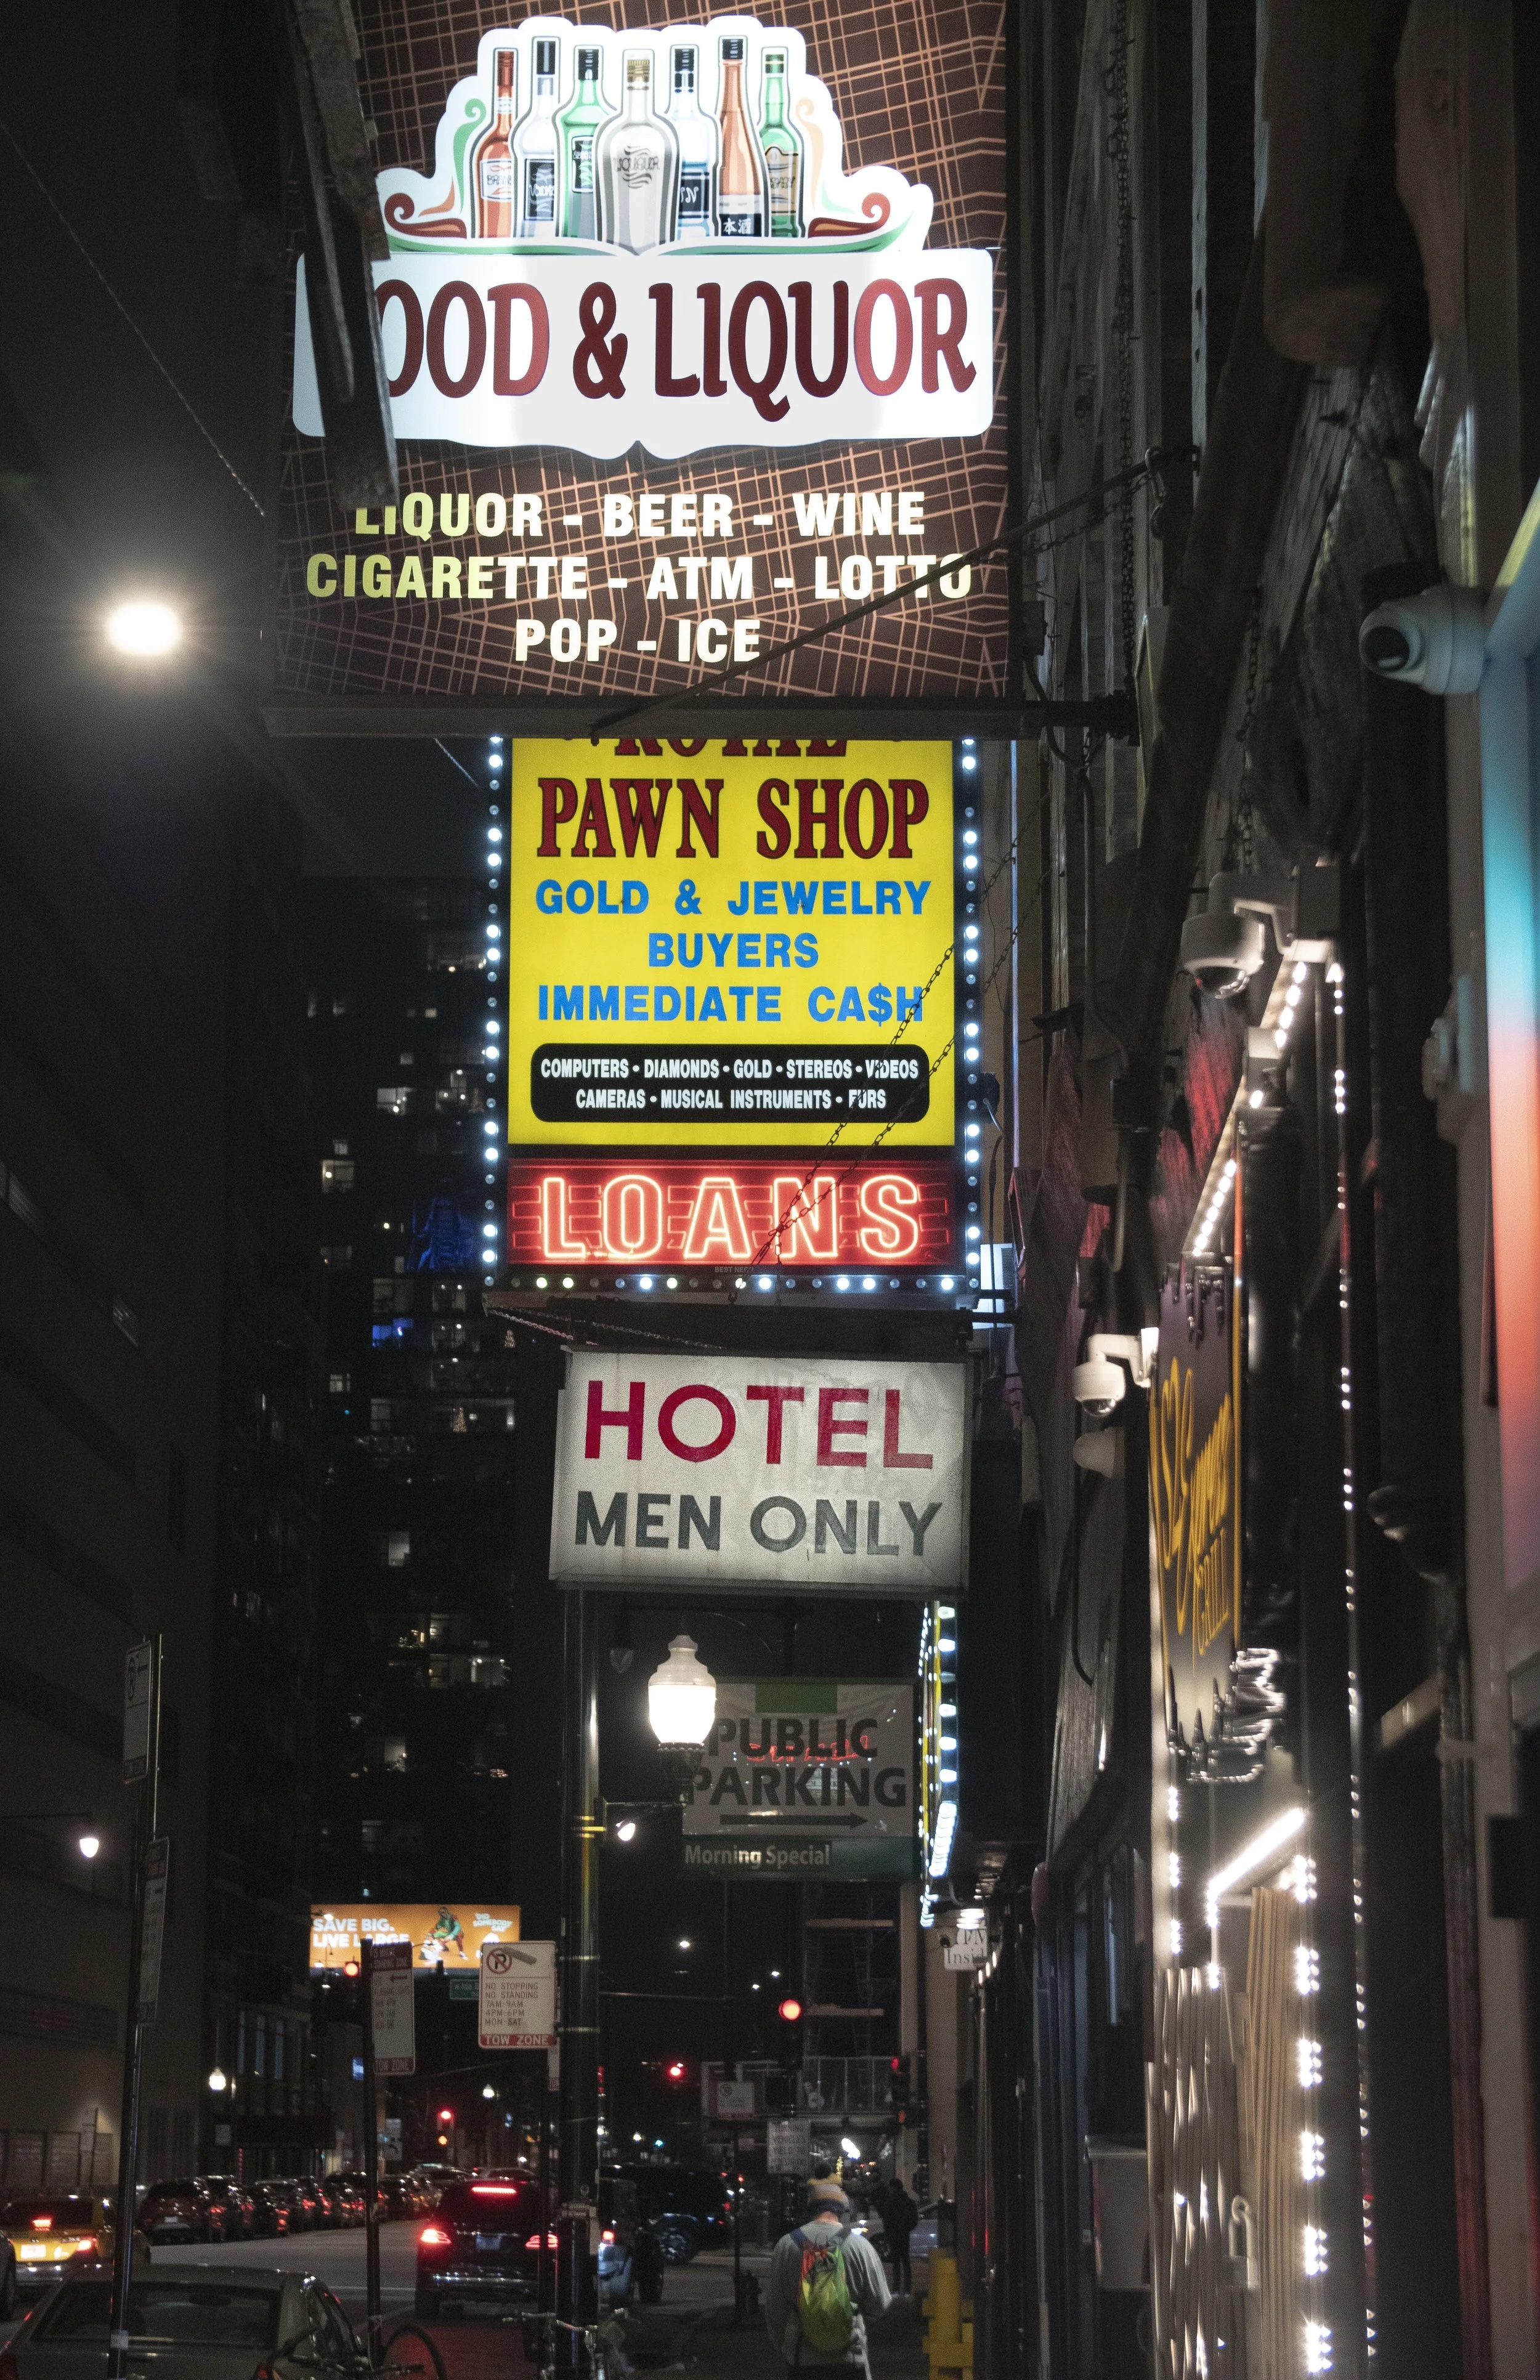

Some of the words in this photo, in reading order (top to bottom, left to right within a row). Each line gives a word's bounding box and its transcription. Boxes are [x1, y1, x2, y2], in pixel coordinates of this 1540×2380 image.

[376, 278, 549, 399] OOD
[572, 281, 628, 400] &
[648, 278, 977, 423] LIQUOR
[355, 492, 543, 542] LIQUOR
[603, 493, 734, 537] BEER
[793, 492, 925, 536] WINE
[307, 554, 588, 599] CIGARETTE
[646, 556, 753, 600] ATM
[814, 553, 971, 600] LOTTO
[516, 618, 617, 662] POP
[678, 618, 760, 663] ICE
[537, 778, 724, 859] PAWN
[756, 778, 930, 859] SHOP
[537, 879, 649, 915] GOLD
[675, 878, 702, 915] &
[727, 880, 931, 915] JEWELRY
[649, 933, 819, 968] BUYERS
[539, 986, 782, 1022] IMMEDIATE
[808, 982, 923, 1028] CA$H
[541, 1059, 629, 1080] COMPUTERS
[644, 1059, 719, 1080] DIAMONDS
[733, 1059, 772, 1080] GOLD
[786, 1059, 852, 1080] STEREOS
[865, 1059, 919, 1080] VIDEOS
[575, 1089, 646, 1109] CAMERAS
[660, 1089, 723, 1109] MUSICAL
[731, 1089, 832, 1109] INSTRUMENTS
[848, 1089, 886, 1109] FURS
[540, 1173, 919, 1260] LOANS
[585, 1380, 933, 1469] HOTEL
[575, 1491, 721, 1551] MEN
[750, 1496, 942, 1556] ONLY
[708, 1717, 878, 1758] PUBLIC
[687, 1767, 906, 1807] PARKING
[684, 1845, 762, 1869] Morning
[766, 1844, 830, 1869] Special
[313, 1918, 357, 1932] SAVE
[313, 1933, 349, 1947] LIVE
[485, 2036, 509, 2044] TOW
[516, 2036, 549, 2044] ZONE
